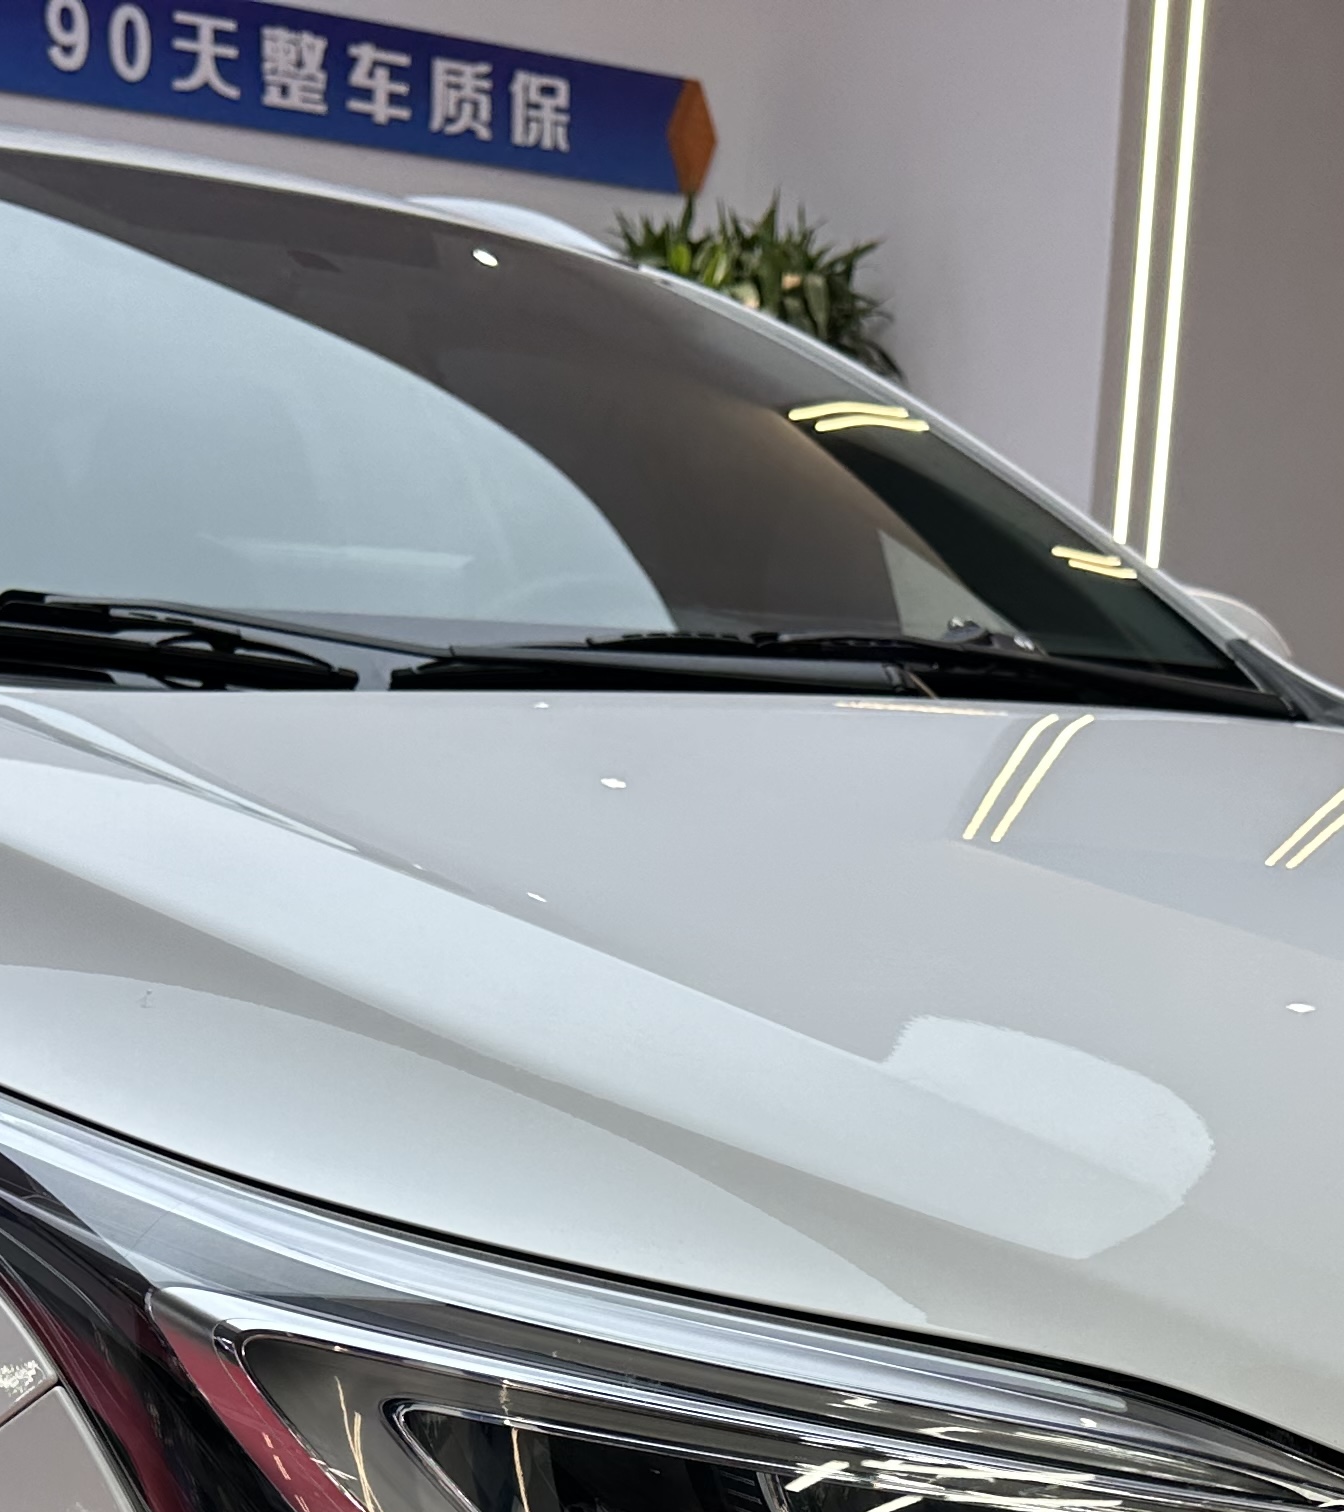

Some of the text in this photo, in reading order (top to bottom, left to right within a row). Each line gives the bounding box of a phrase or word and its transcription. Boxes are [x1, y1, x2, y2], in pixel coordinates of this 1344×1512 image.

[45, 0, 570, 153] 90天整车质保
